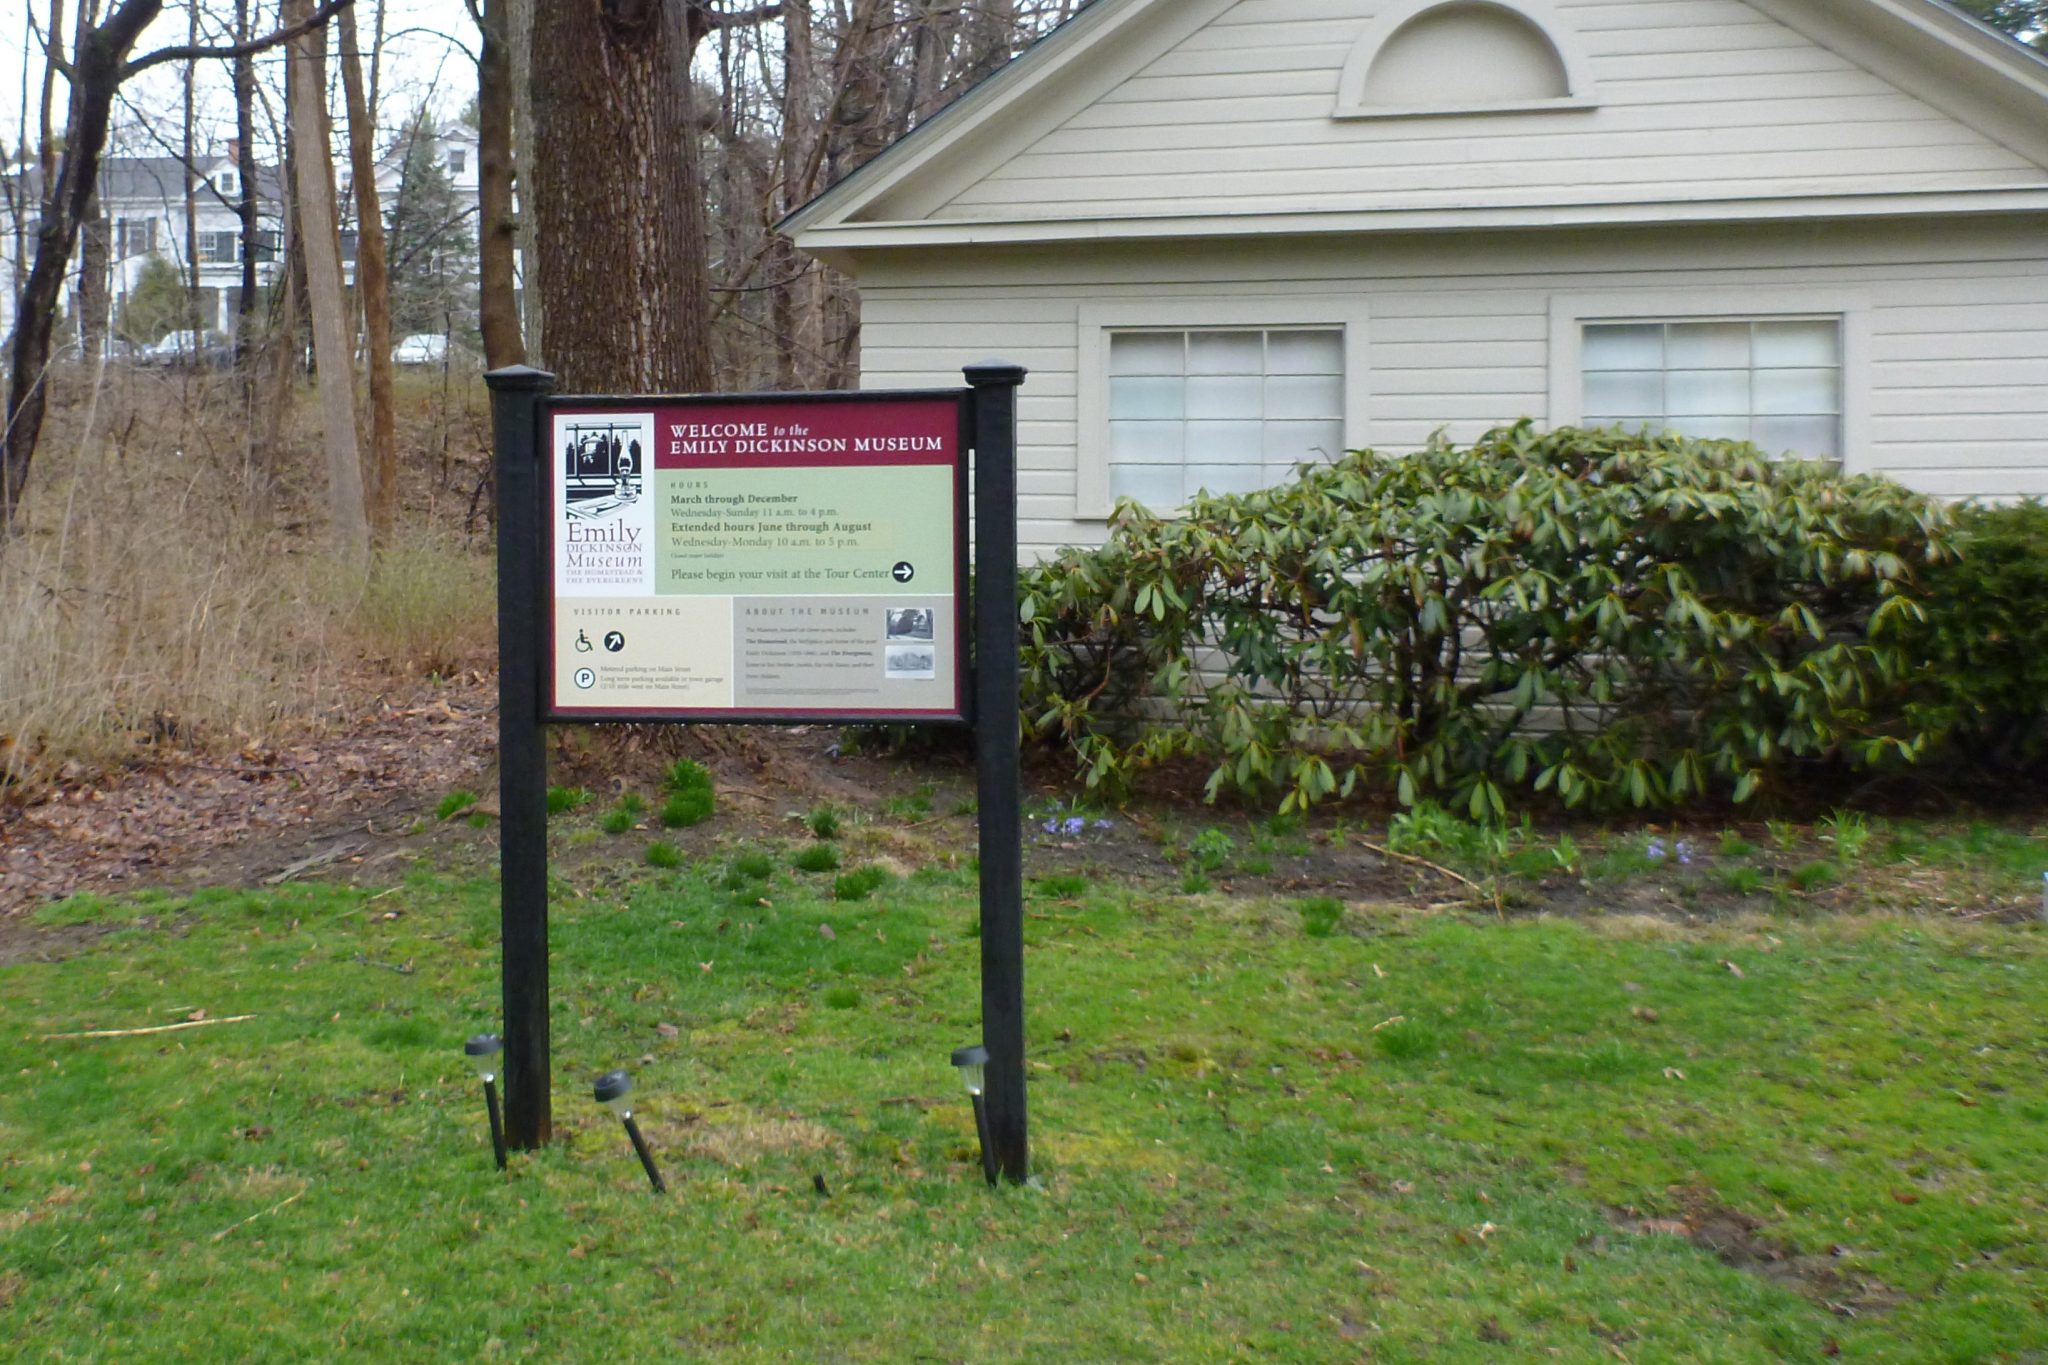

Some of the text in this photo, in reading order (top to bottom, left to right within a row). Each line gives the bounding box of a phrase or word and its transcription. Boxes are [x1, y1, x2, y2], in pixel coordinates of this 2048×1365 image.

[670, 424, 808, 438] WELCOME to the
[670, 437, 942, 454] EMILY DICKINSON MUSEUM
[670, 481, 708, 489] HOURS
[671, 493, 798, 506] March through December
[763, 508, 772, 516] 11
[798, 508, 807, 516] to
[810, 507, 816, 516] 4
[671, 521, 872, 534] Extended hours June through August
[566, 518, 642, 550] Emily
[777, 537, 788, 546] 10
[815, 537, 825, 546] to
[828, 537, 834, 546] 5
[566, 543, 642, 553] DICKINSON
[566, 553, 642, 567] Museum
[671, 567, 890, 582] Please begin your visit at the Tour Center
[573, 608, 680, 616] VISITOR PARKING
[745, 607, 869, 616] ABOUT THE MUSEUM
[581, 673, 590, 683] P
